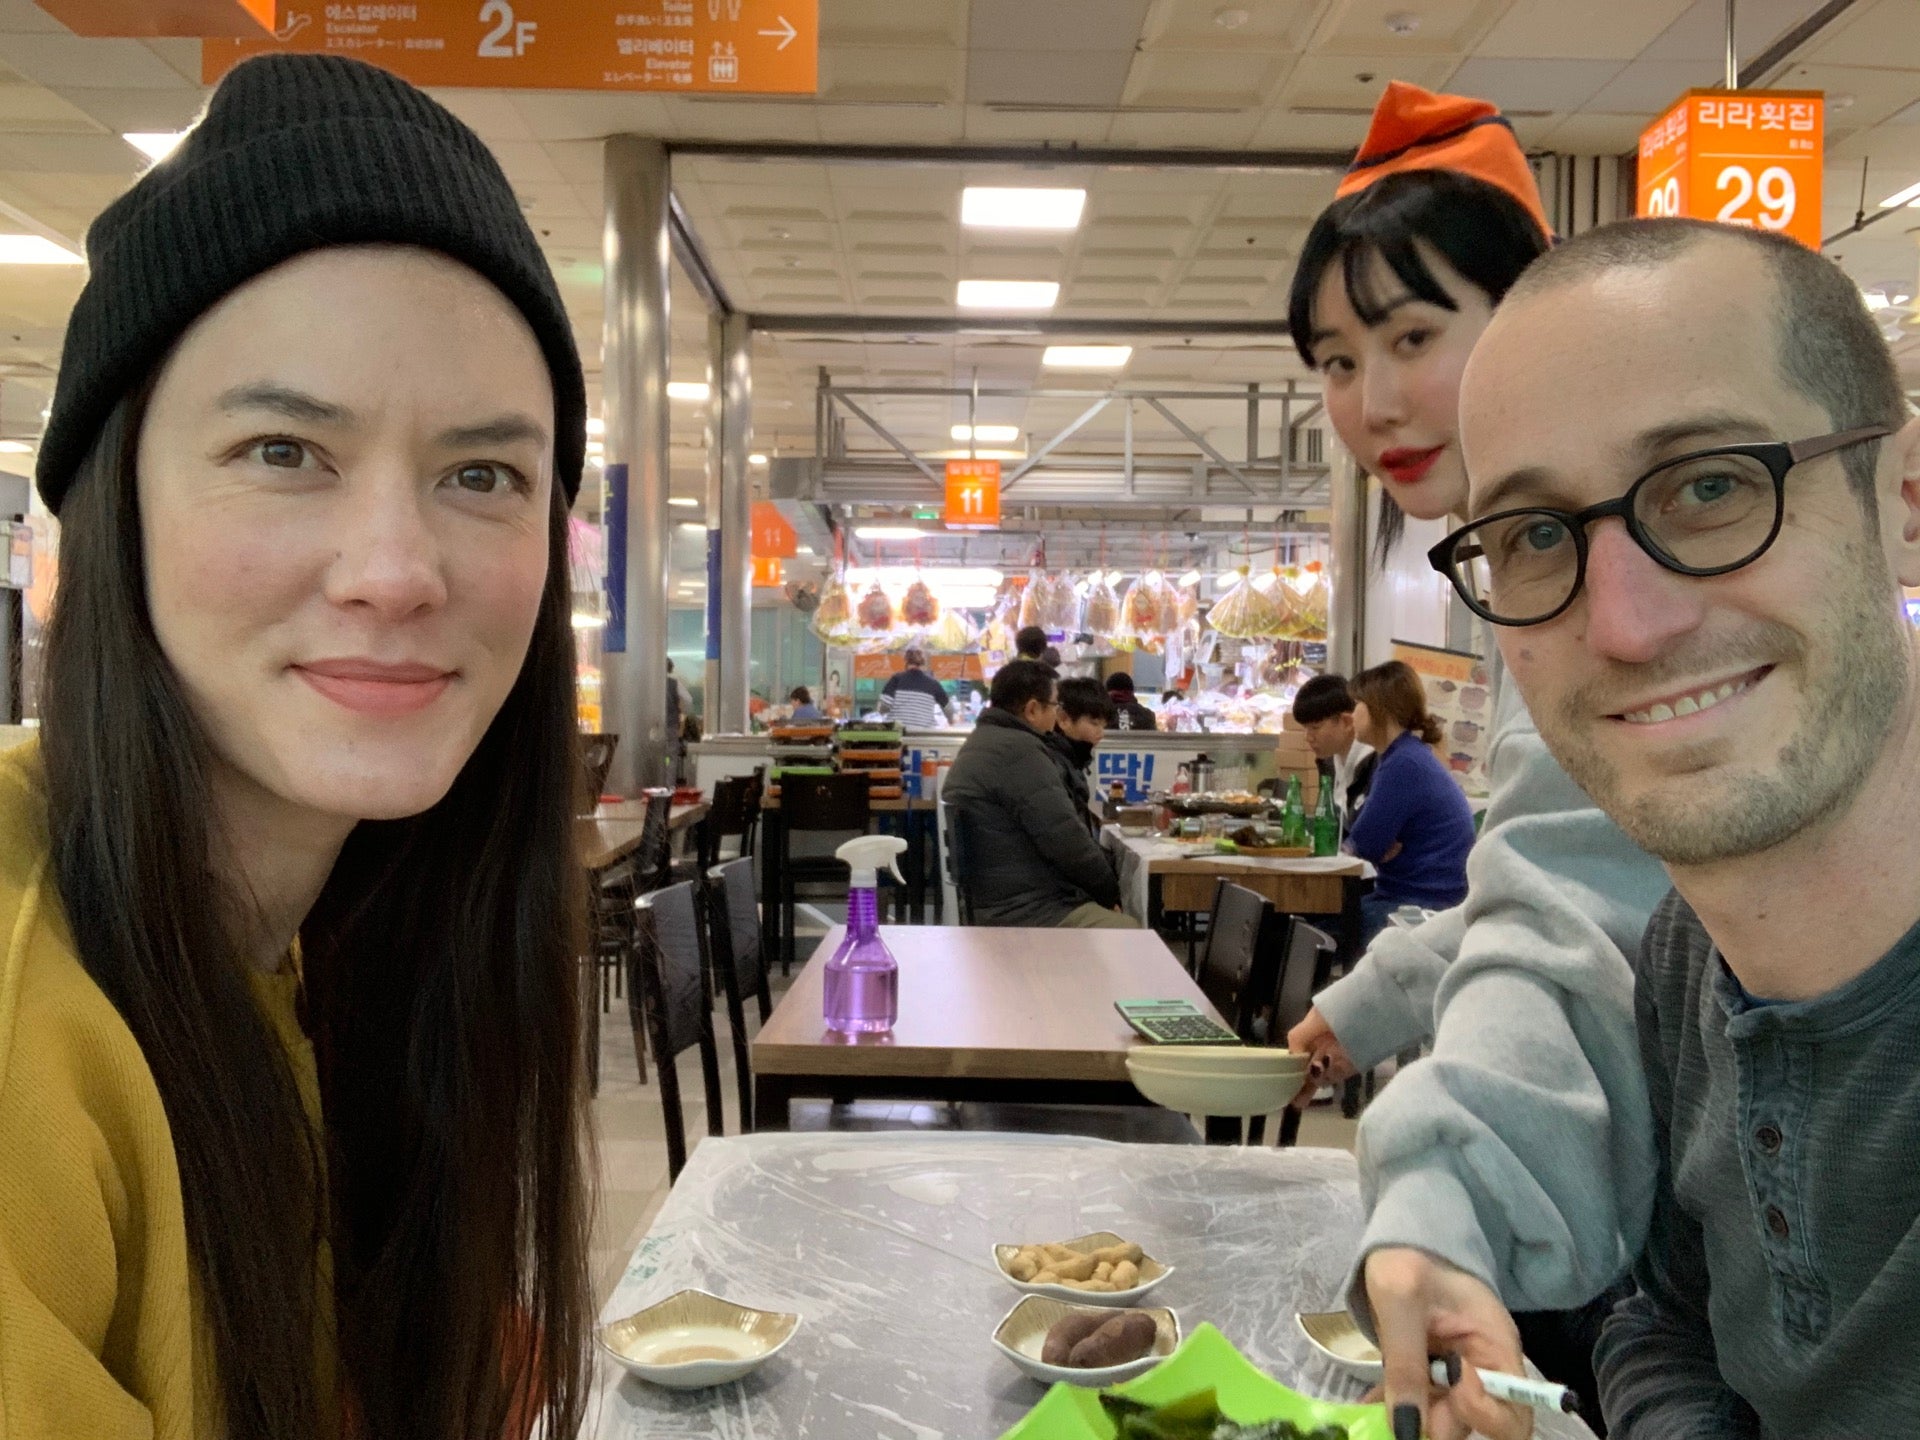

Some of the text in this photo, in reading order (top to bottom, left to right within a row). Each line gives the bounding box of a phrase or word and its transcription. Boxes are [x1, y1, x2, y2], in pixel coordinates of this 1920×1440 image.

[478, 0, 538, 57] 2F
[1716, 165, 1796, 230] 29
[960, 487, 984, 514] 11
